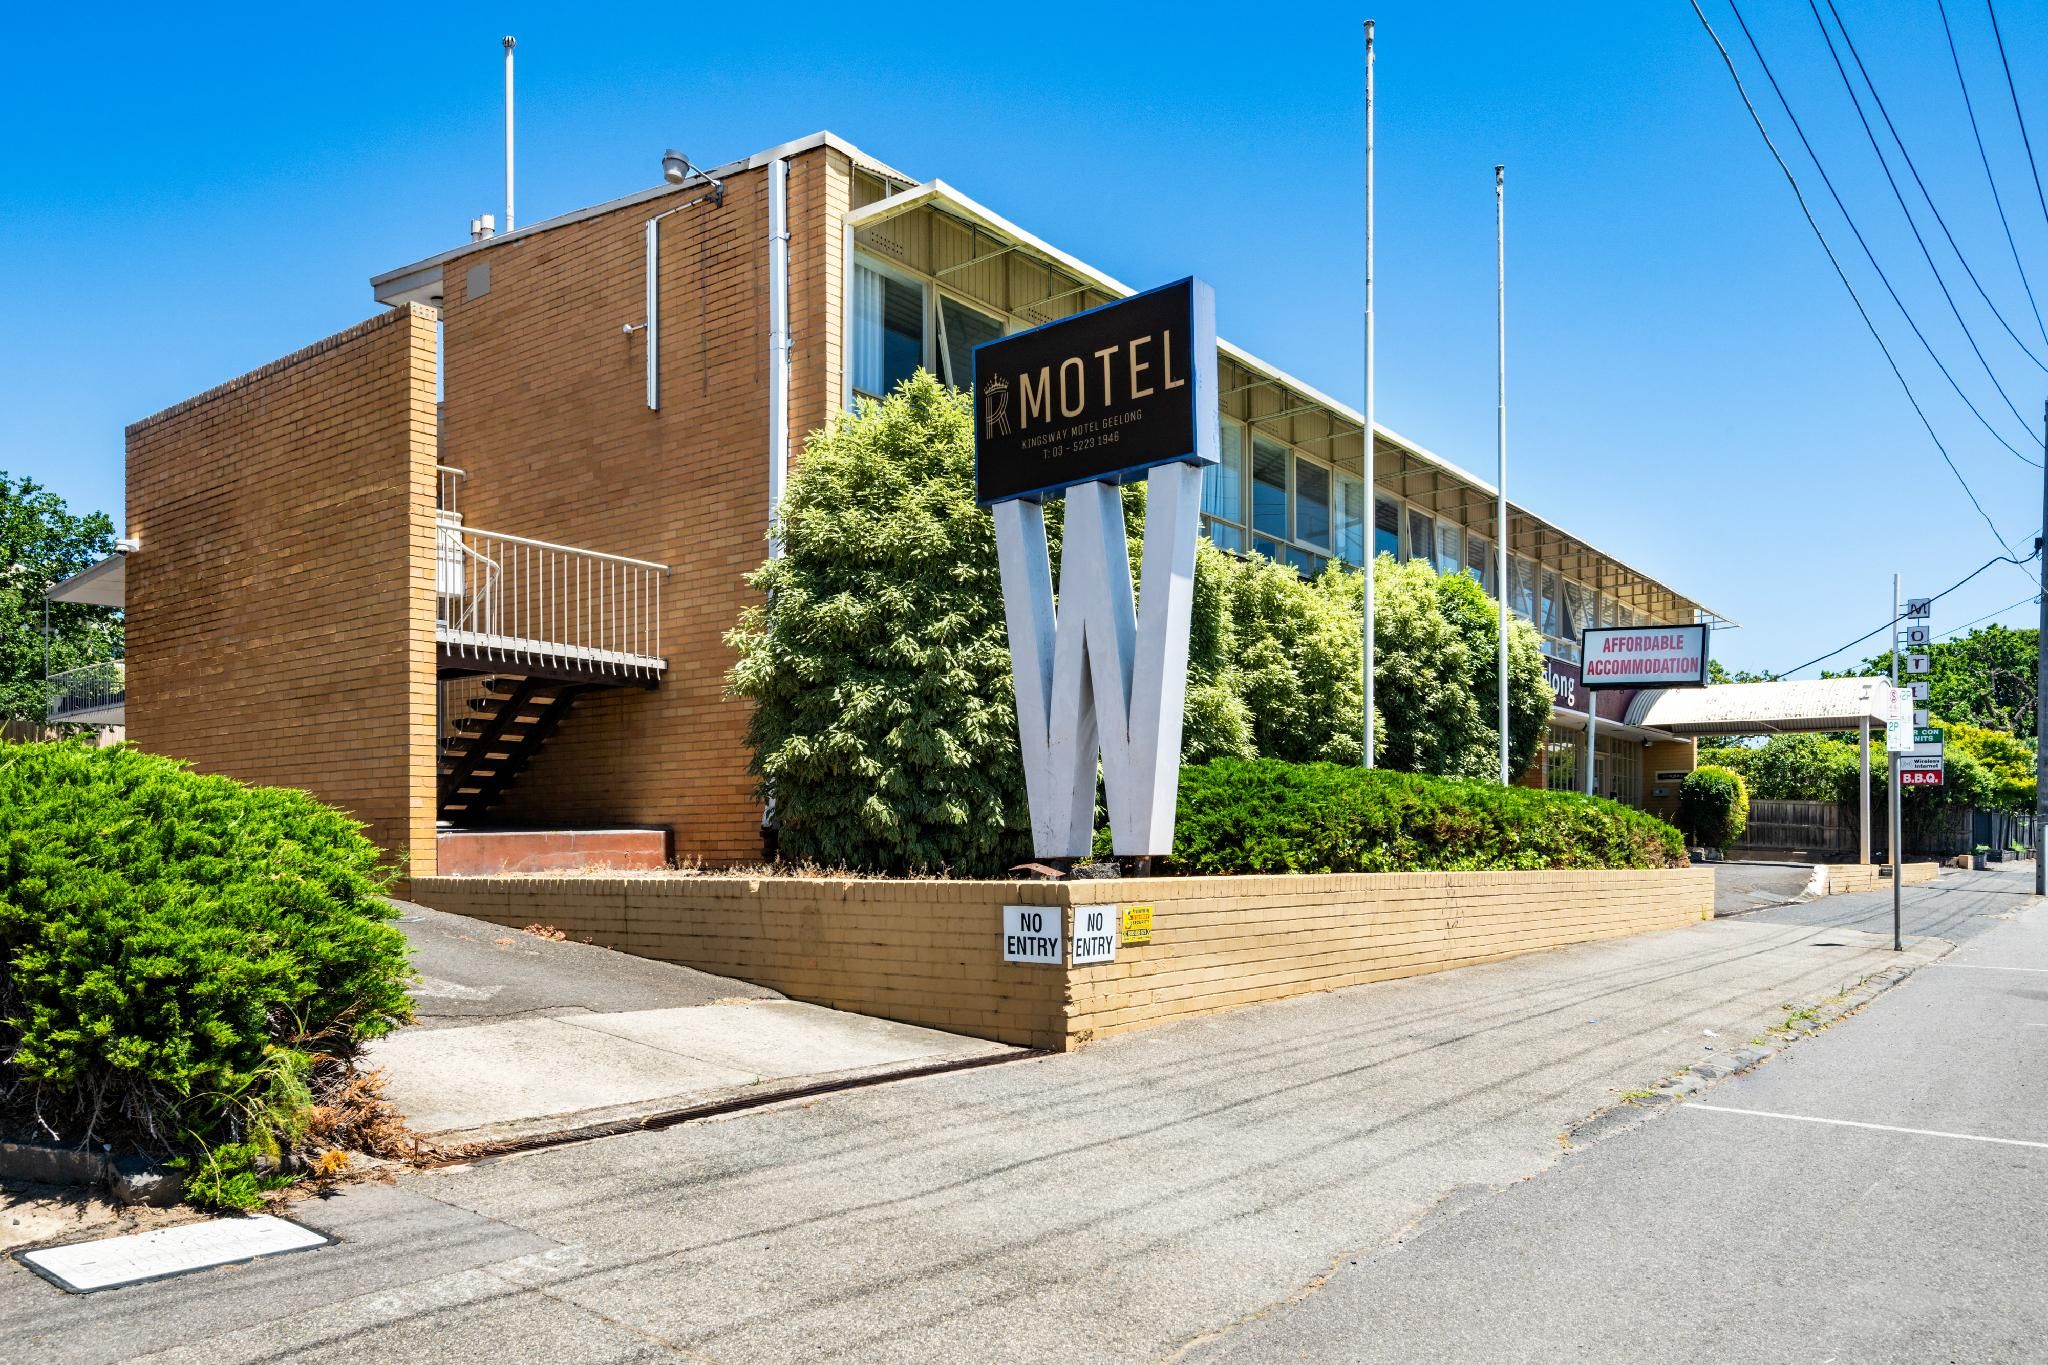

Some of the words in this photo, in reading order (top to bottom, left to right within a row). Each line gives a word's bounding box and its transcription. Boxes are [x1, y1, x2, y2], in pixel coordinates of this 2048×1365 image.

[1019, 329, 1185, 429] MOTEL
[1021, 428, 1068, 449] KINGSWAY
[1071, 420, 1099, 437] MOTEL
[1102, 408, 1142, 429] GEELONG
[1073, 437, 1095, 452] 5223
[1602, 634, 1684, 653] AFFORDABLE
[1586, 656, 1699, 676] ACCOMMODATION
[1888, 721, 1899, 732] 2P
[1903, 772, 1939, 783] B.B.Q.
[1020, 912, 1043, 933] NO
[1087, 912, 1103, 932] NO
[1007, 935, 1059, 957] ENTRY
[1075, 935, 1114, 957] ENTRY
